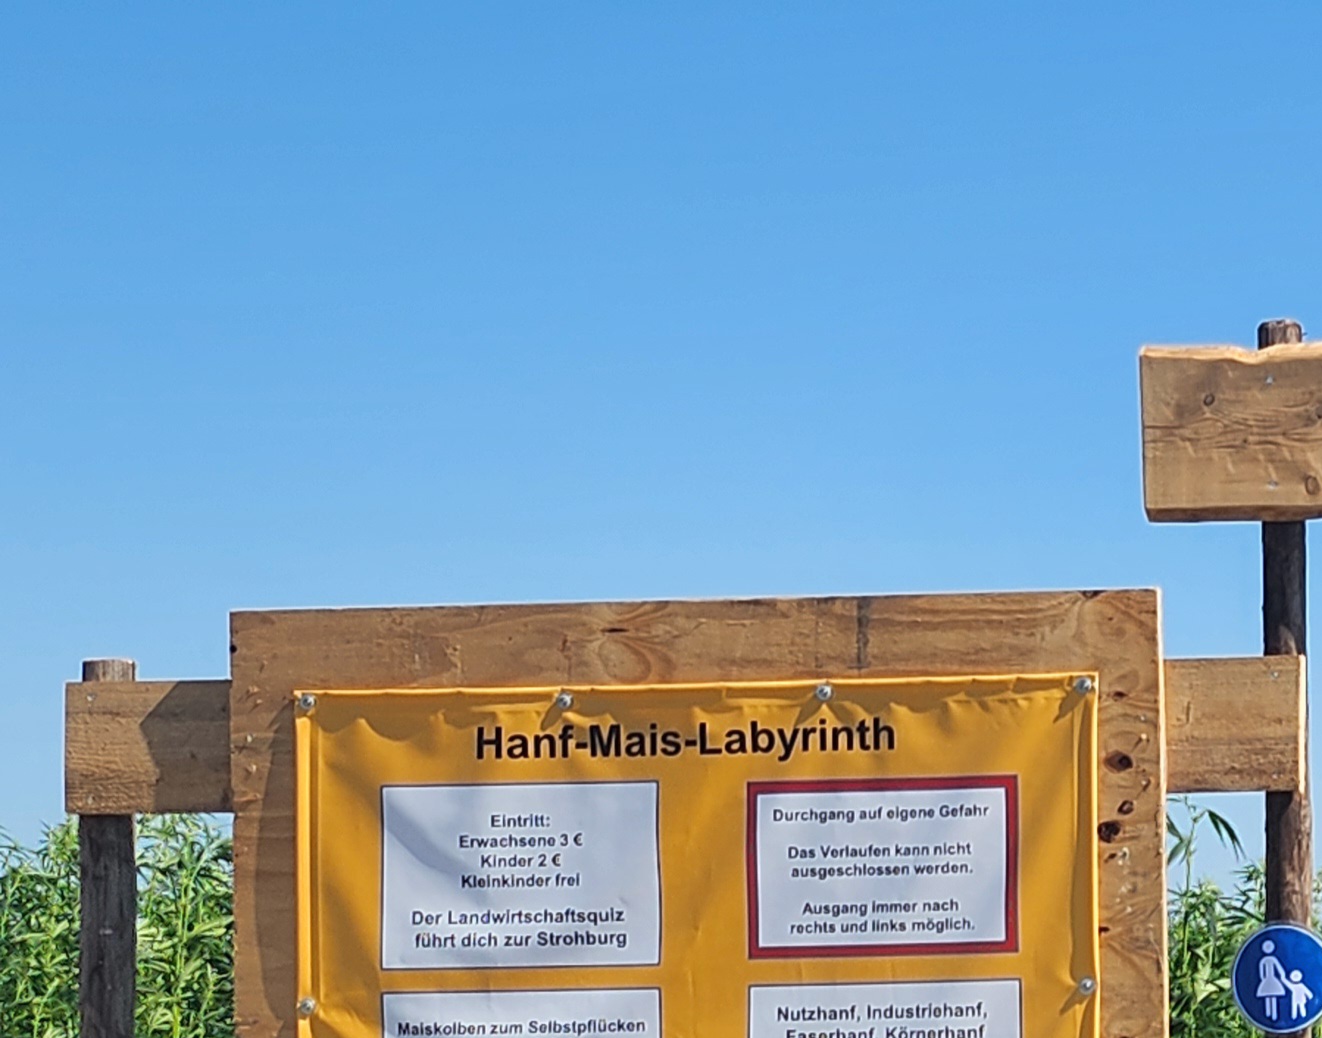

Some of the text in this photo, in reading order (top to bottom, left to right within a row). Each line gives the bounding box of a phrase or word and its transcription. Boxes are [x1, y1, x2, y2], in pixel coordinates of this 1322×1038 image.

[476, 718, 895, 761] Hanf-Mais-Labyrinth
[491, 814, 551, 828] Eintritt:
[773, 804, 989, 823] Durchgang auf eigene Gefahr
[459, 833, 583, 848] Erwachsene 3 €
[788, 843, 971, 859] Das Verlaufen kann nicht
[480, 854, 561, 868] Kinder 2 €
[791, 862, 973, 880] ausgeschlossen werden.
[461, 873, 579, 888] Kleinkinder frei
[803, 899, 958, 916] Ausgang immer nach
[412, 908, 625, 925] Der Landwirtschaftsquiz
[790, 918, 975, 934] rechts und links möglich.
[415, 931, 627, 948] führt dich zur Strohburg
[777, 1002, 987, 1023] Nutzhanf, Industriehanf,
[398, 1019, 646, 1037] Maiskolben zum Selbstpflücken
